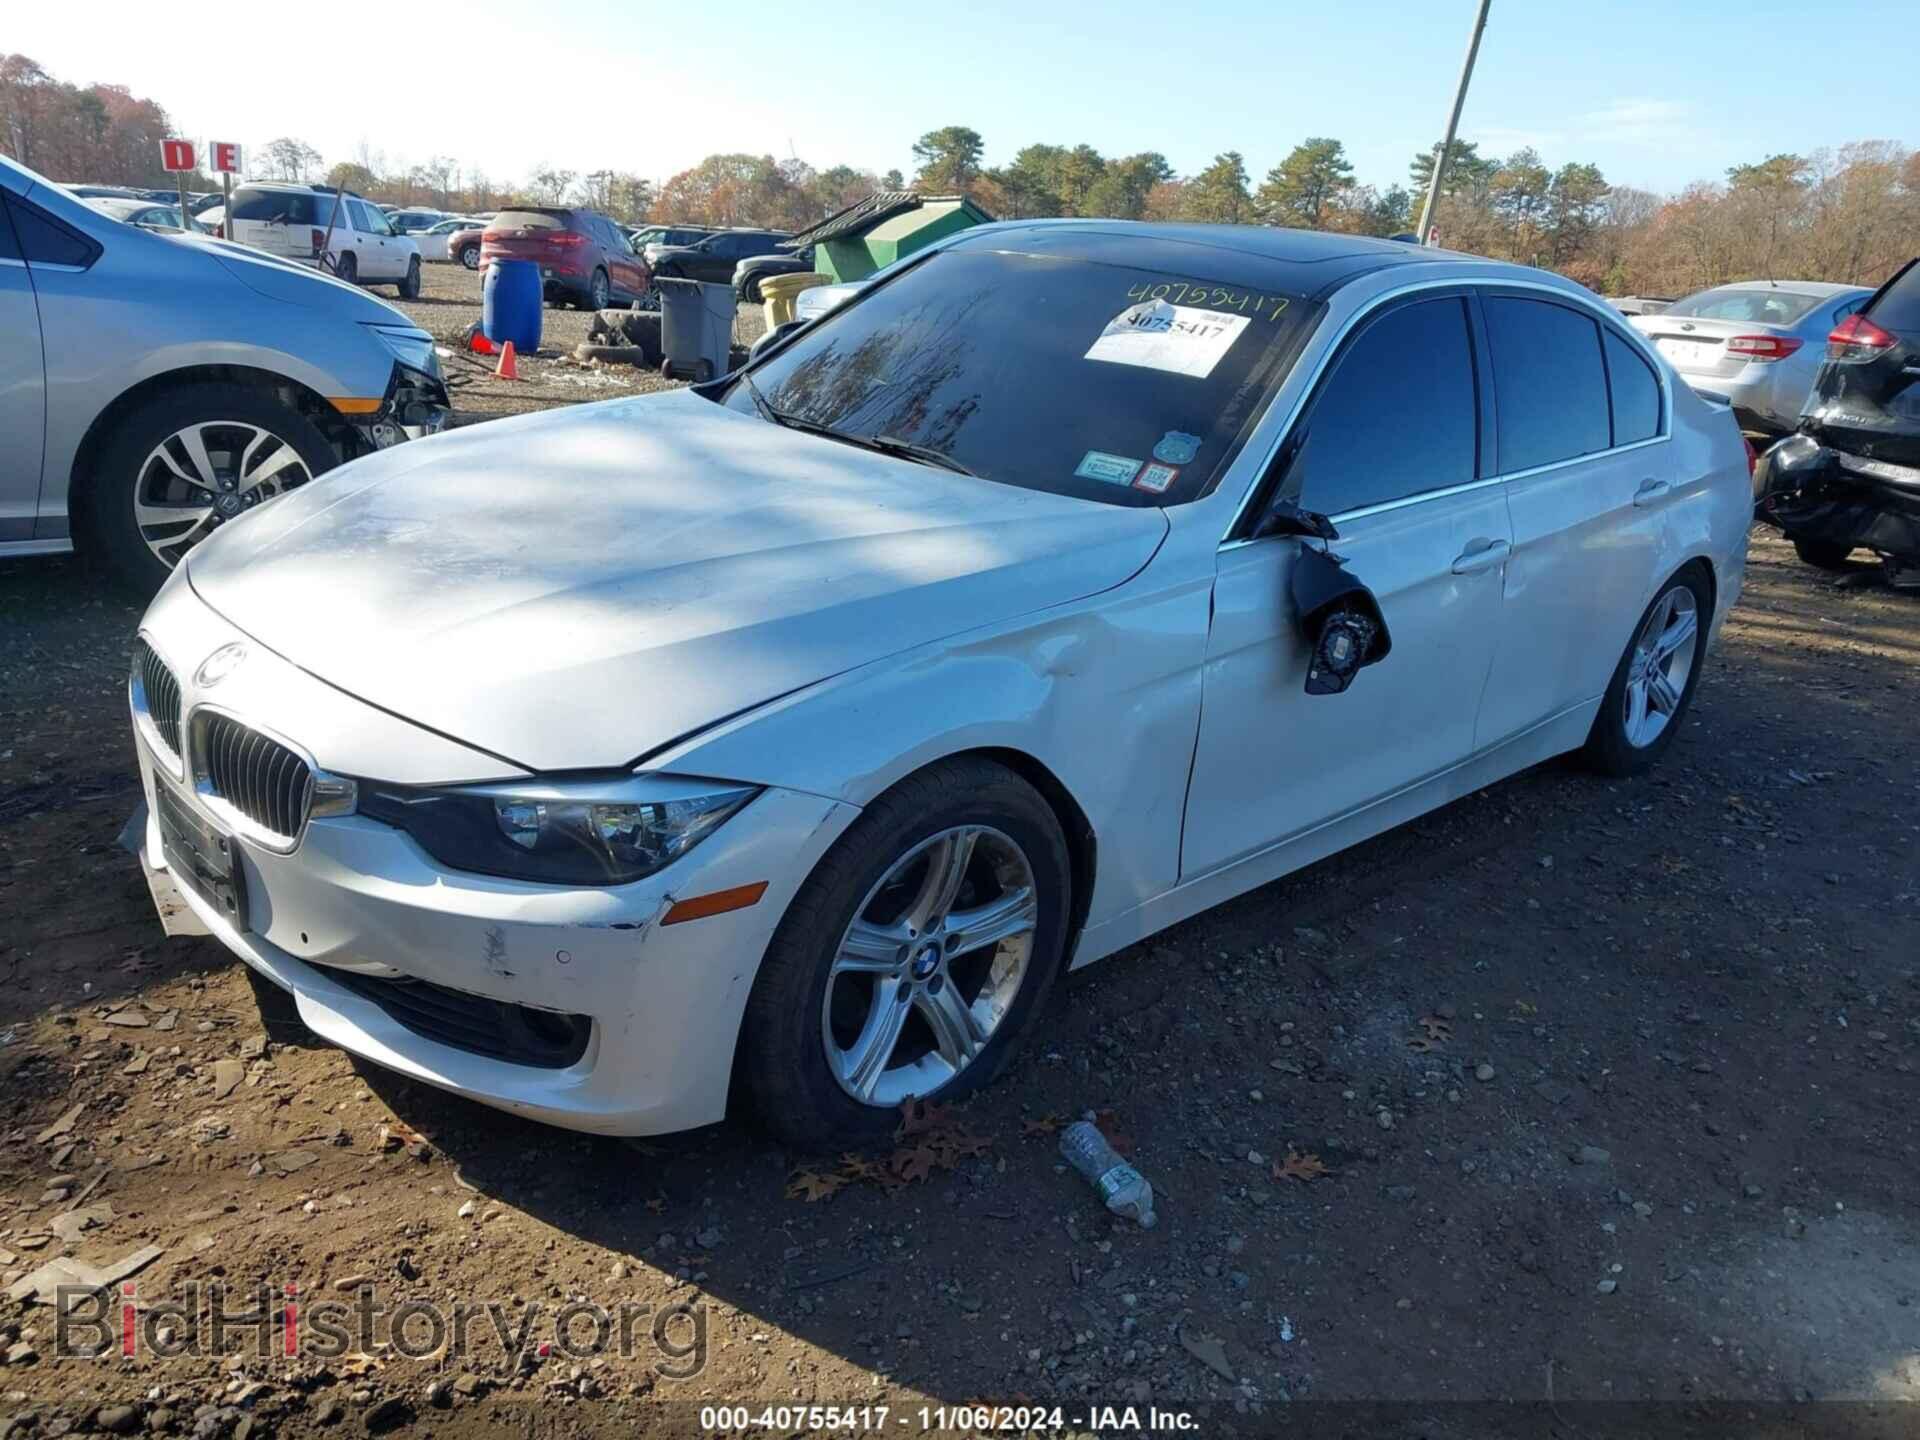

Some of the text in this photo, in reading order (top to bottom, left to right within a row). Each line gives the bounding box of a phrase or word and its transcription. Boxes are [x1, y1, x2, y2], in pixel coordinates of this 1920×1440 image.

[163, 141, 194, 170] D
[217, 143, 236, 171] E
[1127, 282, 1289, 322] 40755417
[1127, 312, 1224, 339] 40755417
